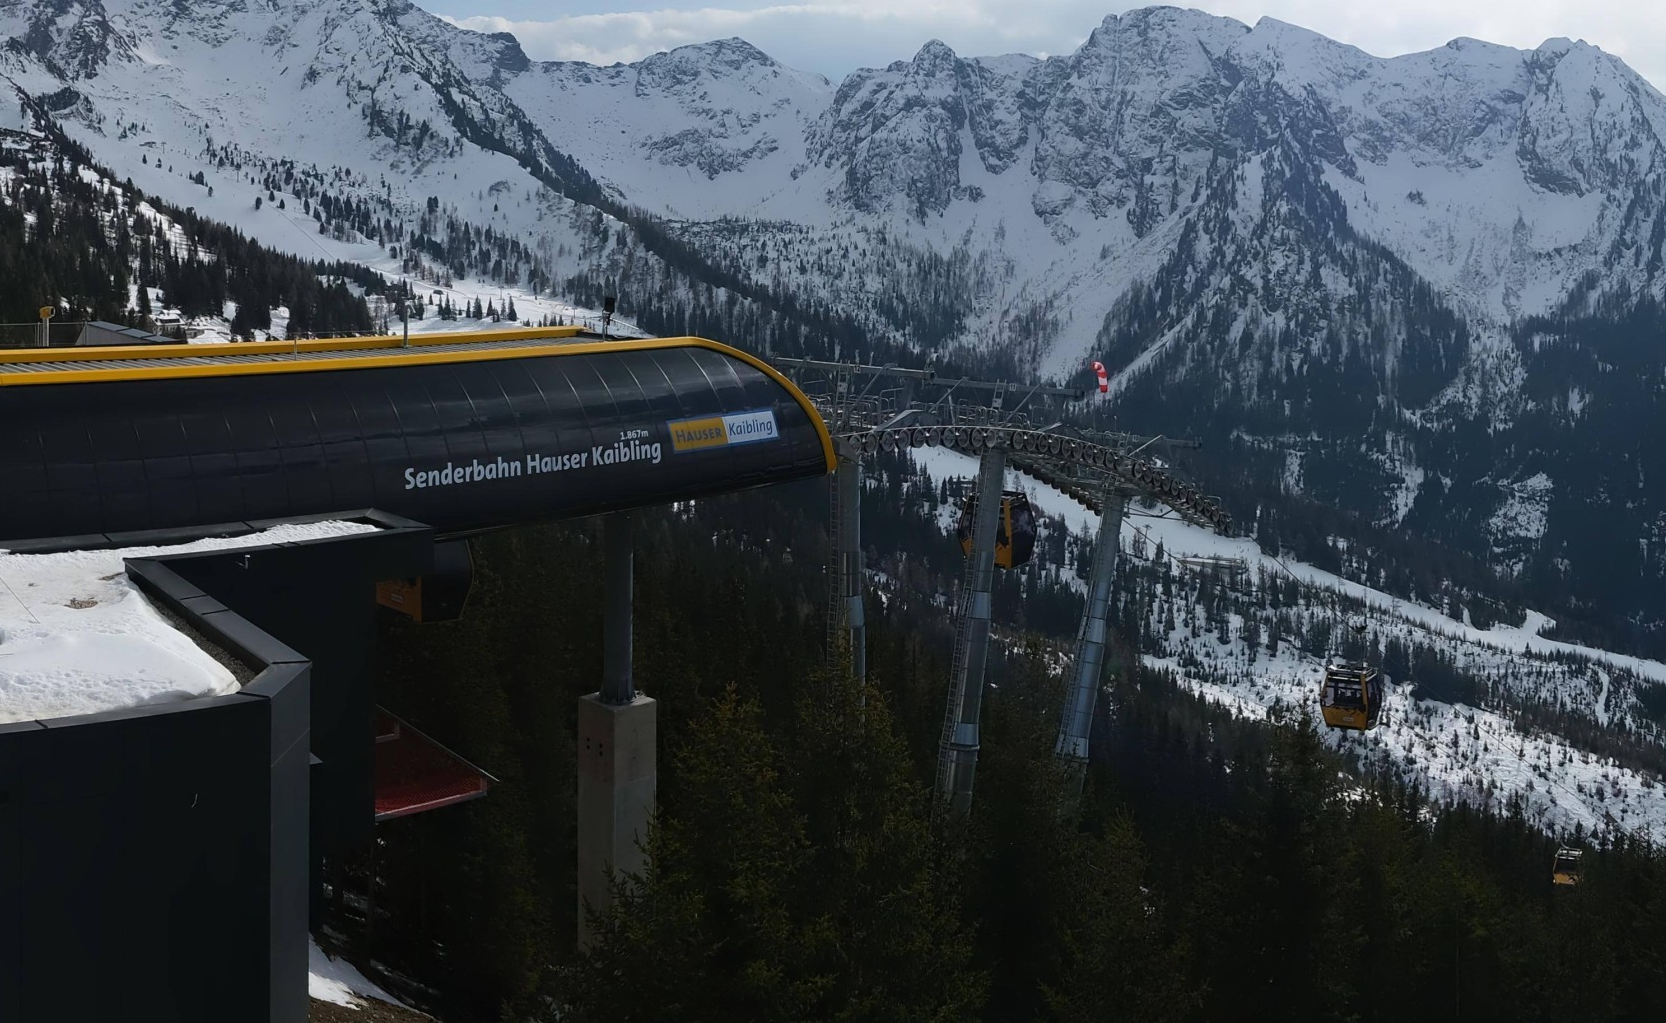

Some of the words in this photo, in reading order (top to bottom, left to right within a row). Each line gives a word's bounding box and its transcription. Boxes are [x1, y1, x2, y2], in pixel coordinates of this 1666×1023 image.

[619, 429, 649, 441] 1.867m
[675, 427, 723, 443] HAUSER
[728, 419, 773, 436] Kaibling
[404, 456, 522, 490] Senderbahn
[526, 451, 588, 475] Hauser
[592, 441, 662, 465] Kaibling
